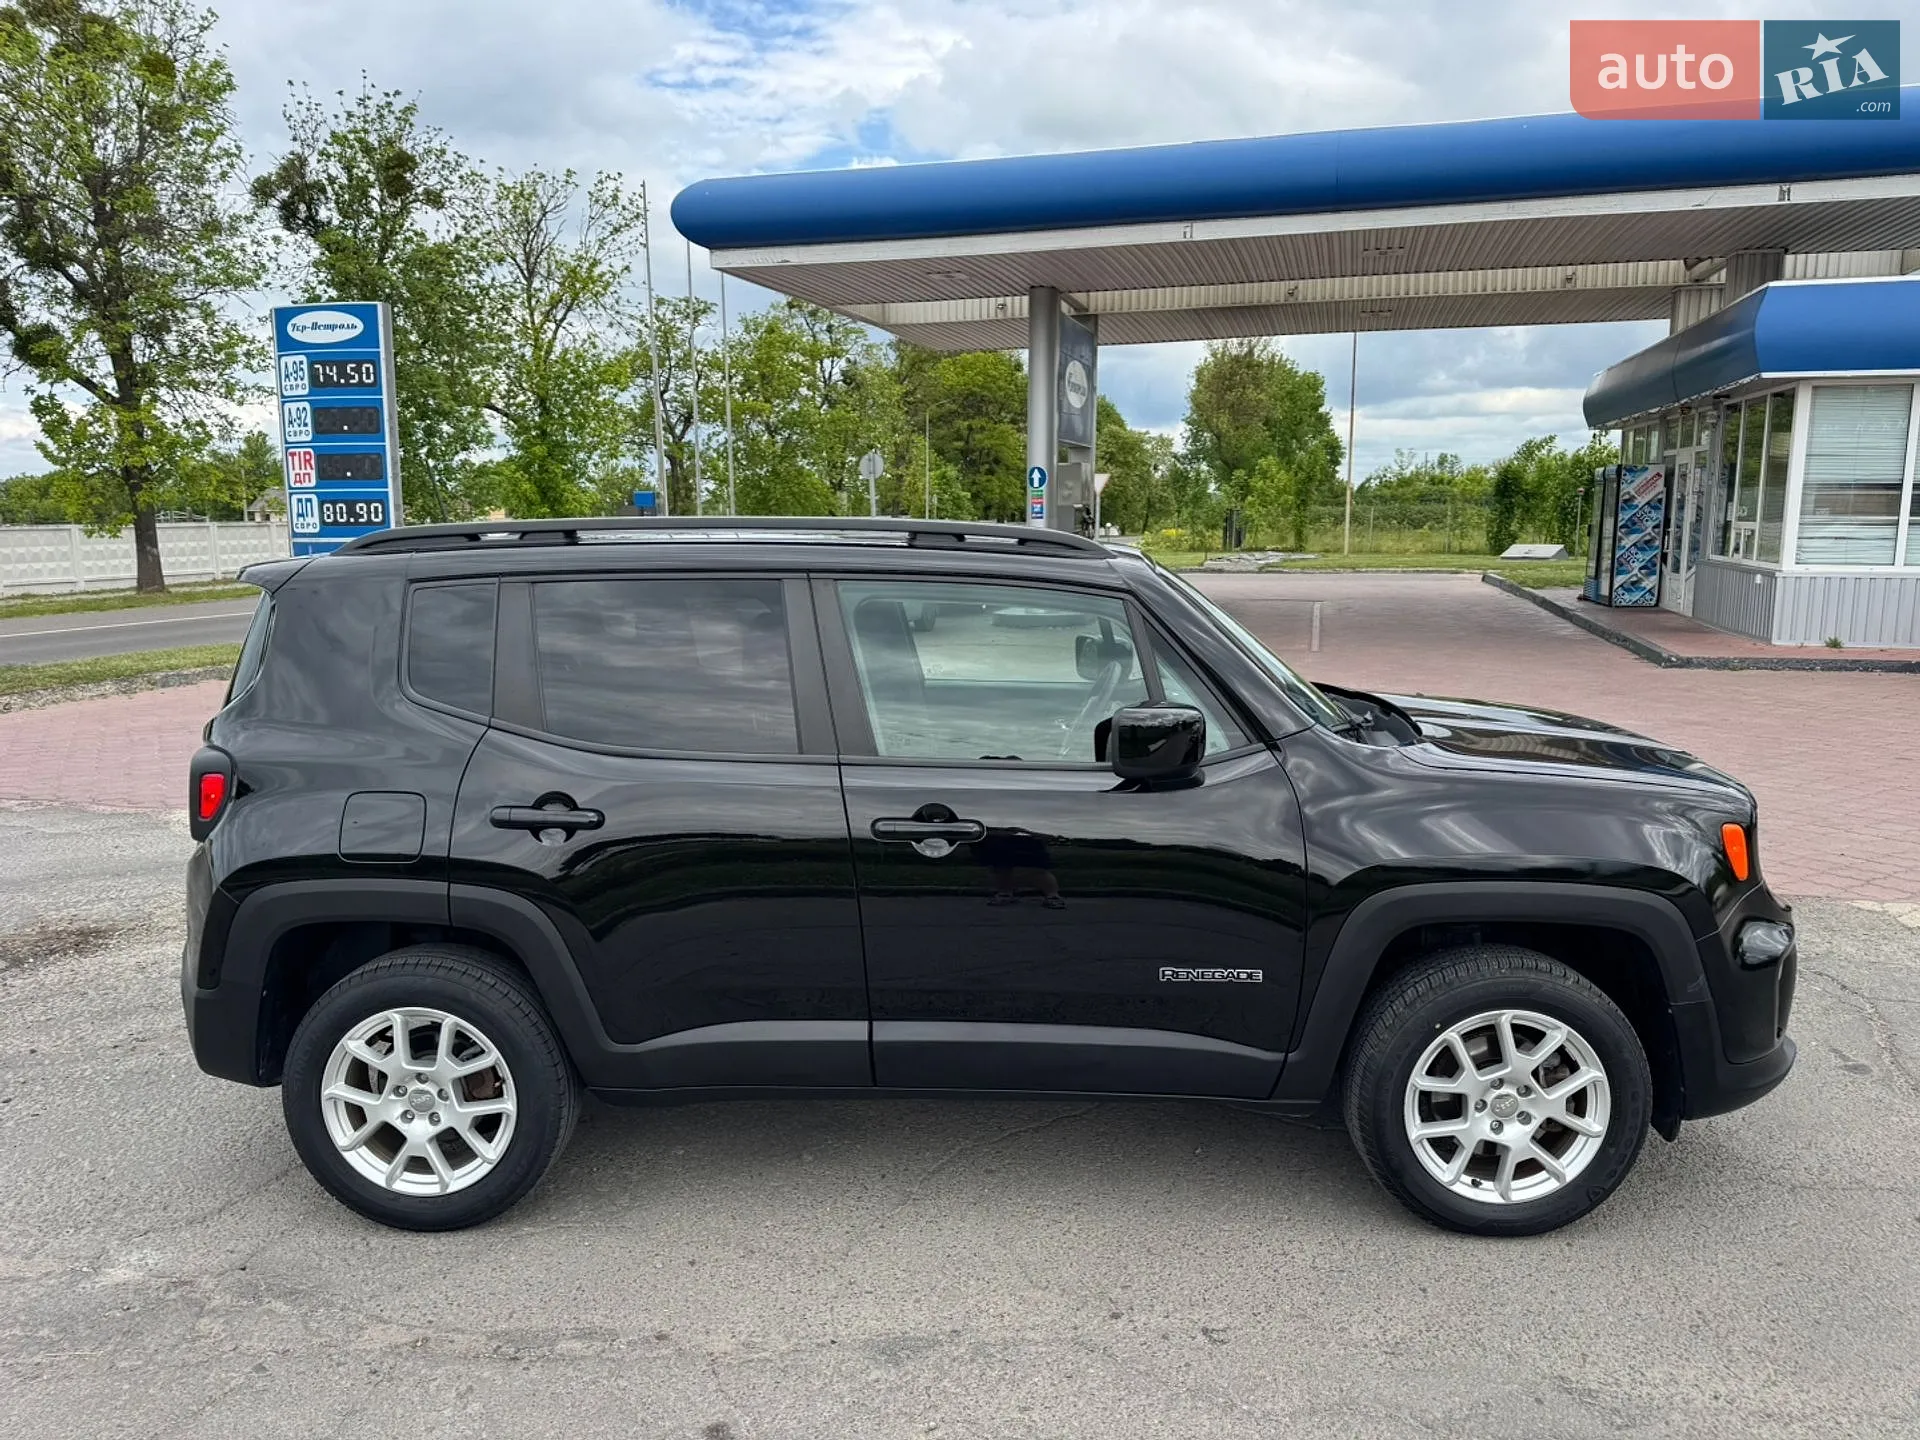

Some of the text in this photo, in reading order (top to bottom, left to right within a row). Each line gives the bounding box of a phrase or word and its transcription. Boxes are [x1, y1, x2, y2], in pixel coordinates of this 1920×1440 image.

[313, 363, 375, 384] 74.50
[288, 450, 314, 471] TIR
[293, 472, 312, 486] ДП
[296, 497, 315, 522] ДП
[322, 502, 383, 523] 80.90
[1159, 966, 1263, 983] RENEGADE
